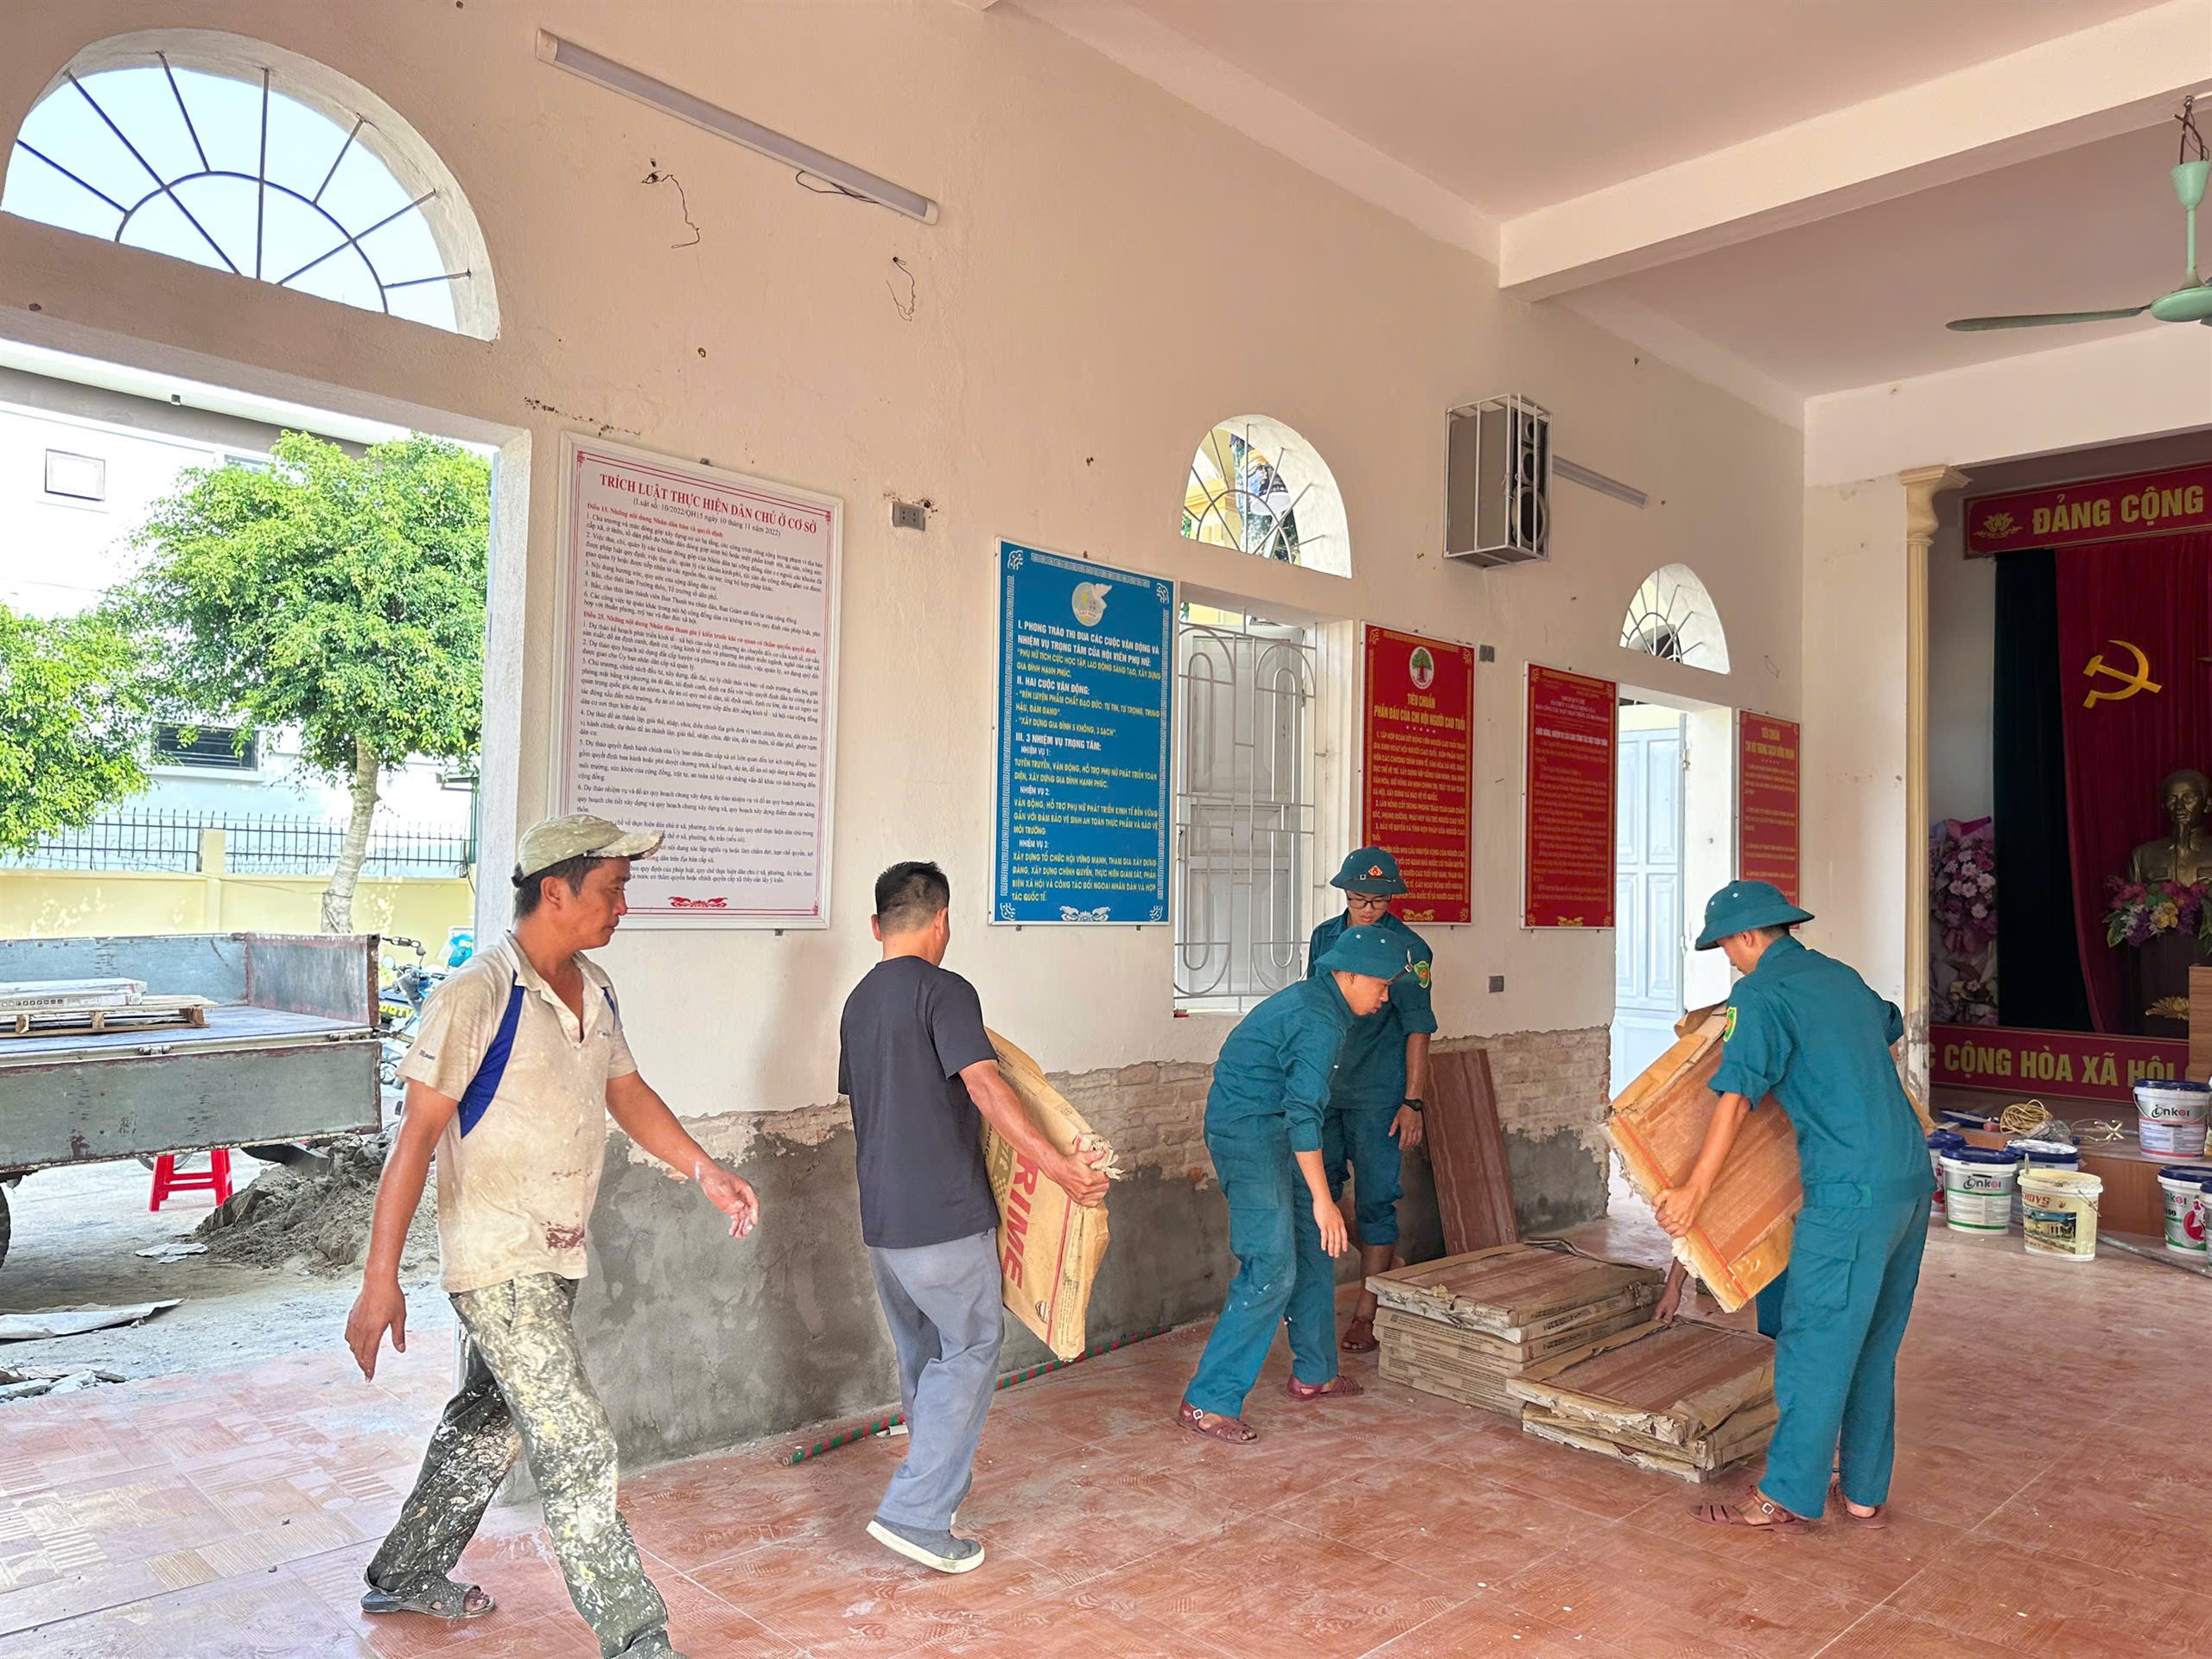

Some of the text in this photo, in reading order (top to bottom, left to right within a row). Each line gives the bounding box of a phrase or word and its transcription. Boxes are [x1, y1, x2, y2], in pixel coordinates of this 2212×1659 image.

[600, 474, 816, 533] TRÍCH LUẬT THỰC HIỆN DÂN CHỦ Ở CƠ SỞ
[2032, 486, 2203, 535] ĐẢNG CỘNG
[1018, 620, 1159, 654] I. PHONG TRÀO THI ĐUA CÁC CUỘC VẬN ĐỘNG VÀ
[1018, 634, 1039, 646] NHIỆM
[1040, 639, 1049, 650] VỤ
[1050, 640, 1071, 652] TRỌNG
[1072, 644, 1086, 655] TÂM
[1088, 646, 1100, 657] CỦA
[1101, 649, 1111, 660] HỘI
[1113, 651, 1126, 662] VIÊN
[1128, 654, 1140, 665] PHỤ
[1025, 677, 1036, 687] HAI
[1038, 678, 1055, 690] CUỘC
[1056, 681, 1069, 692] VẬN
[1071, 683, 1090, 695] ĐỘNG:
[1015, 732, 1101, 750] III. 3 NHIỆM VỤ TRỌNG TÂM:
[1945, 1040, 2012, 1078] CỘNG
[2020, 1045, 2073, 1082] HÒA
[2082, 1052, 2119, 1086] XÃ
[1002, 1153, 1039, 1289] RIME
